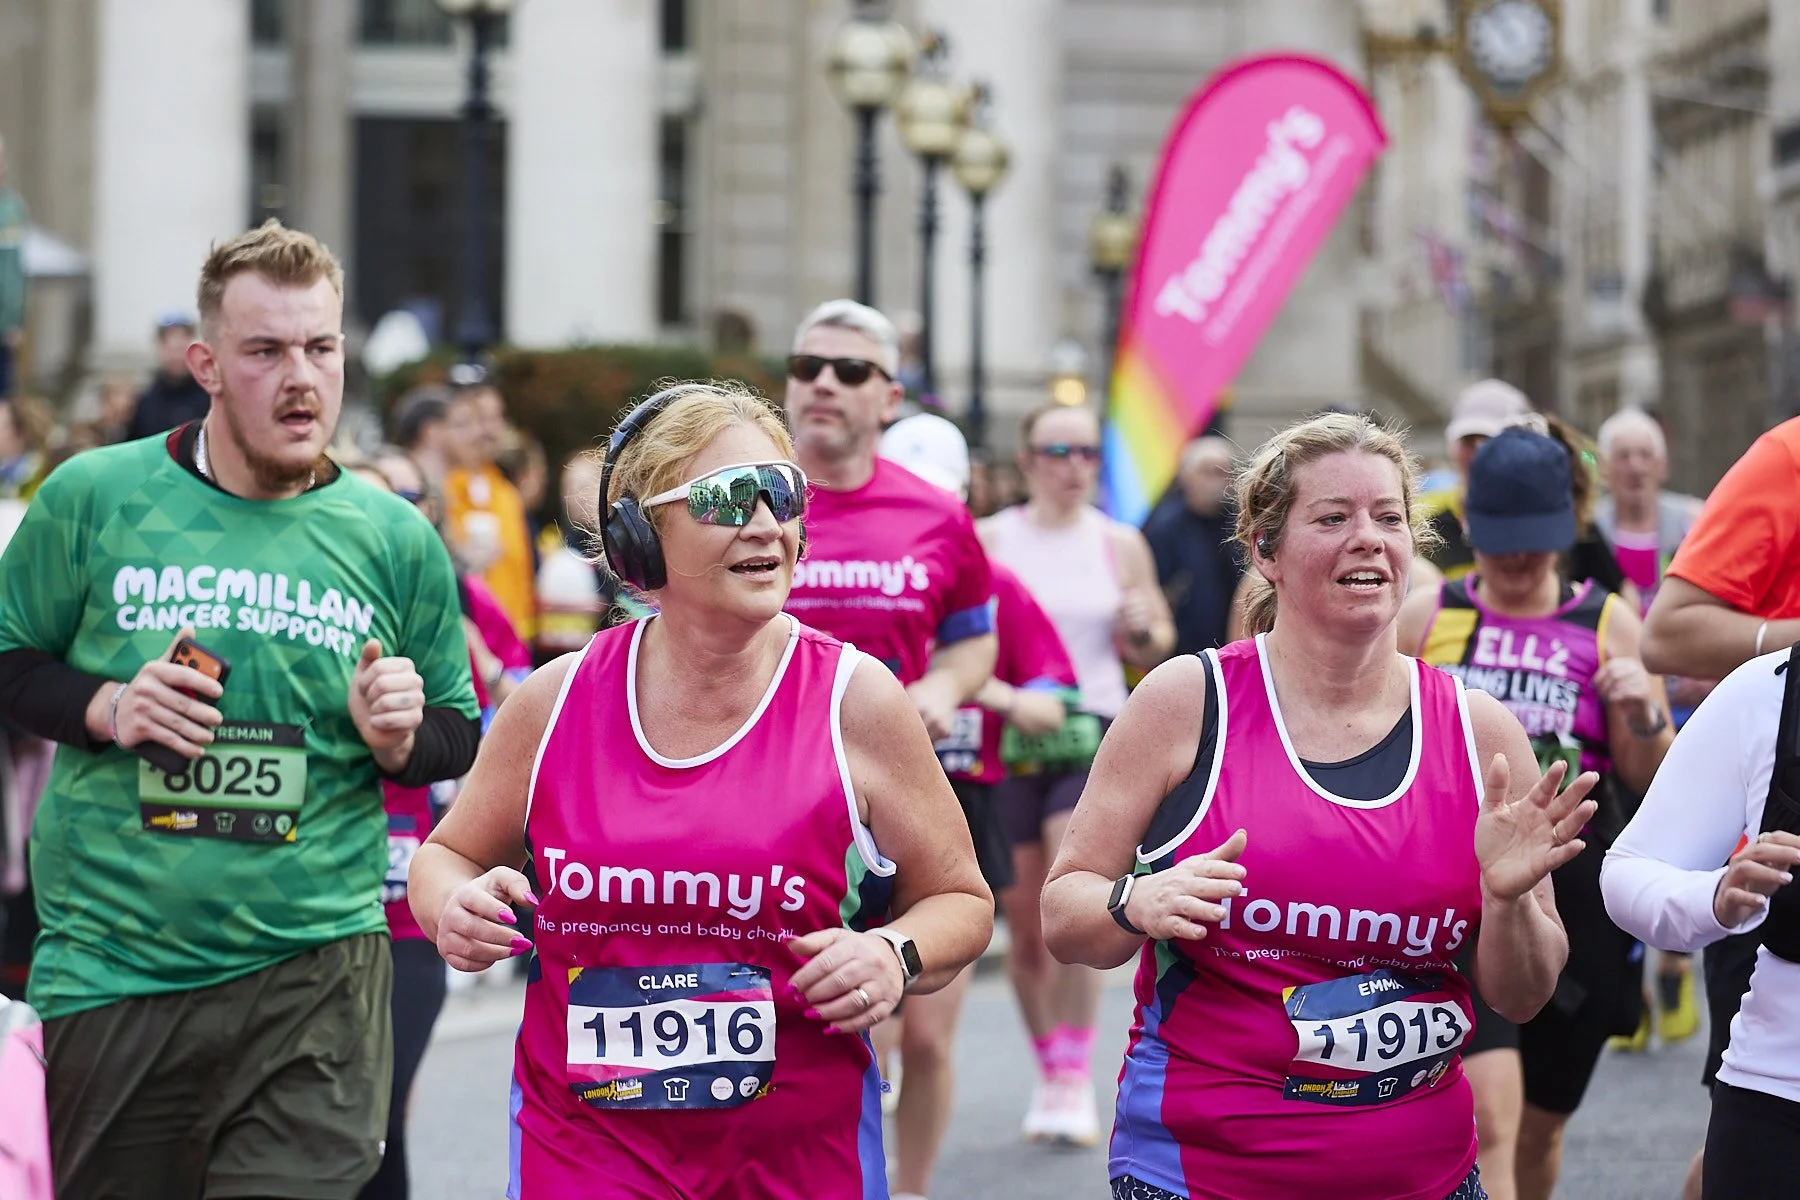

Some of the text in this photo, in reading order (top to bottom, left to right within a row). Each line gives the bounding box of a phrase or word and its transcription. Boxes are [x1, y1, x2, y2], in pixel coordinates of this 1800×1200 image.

[1154, 105, 1324, 323] Tommy's
[113, 565, 375, 635] MACMILLAN
[790, 555, 930, 596] ommy's
[116, 603, 357, 657] CANCER SUPPORT
[543, 847, 806, 921] Tommy's
[537, 915, 556, 932] The
[561, 921, 652, 936] pregnancy
[657, 921, 692, 935] and
[697, 922, 742, 941] baby
[1219, 887, 1468, 957] Tommy's
[638, 973, 699, 990] CLARE
[1210, 946, 1241, 960] The
[1336, 954, 1365, 969] and
[1369, 955, 1410, 970] baby
[583, 1006, 764, 1058] 11916
[1313, 1006, 1463, 1062] 11913
[583, 1087, 609, 1099] LONDON
[1299, 1083, 1326, 1092] LONDON
